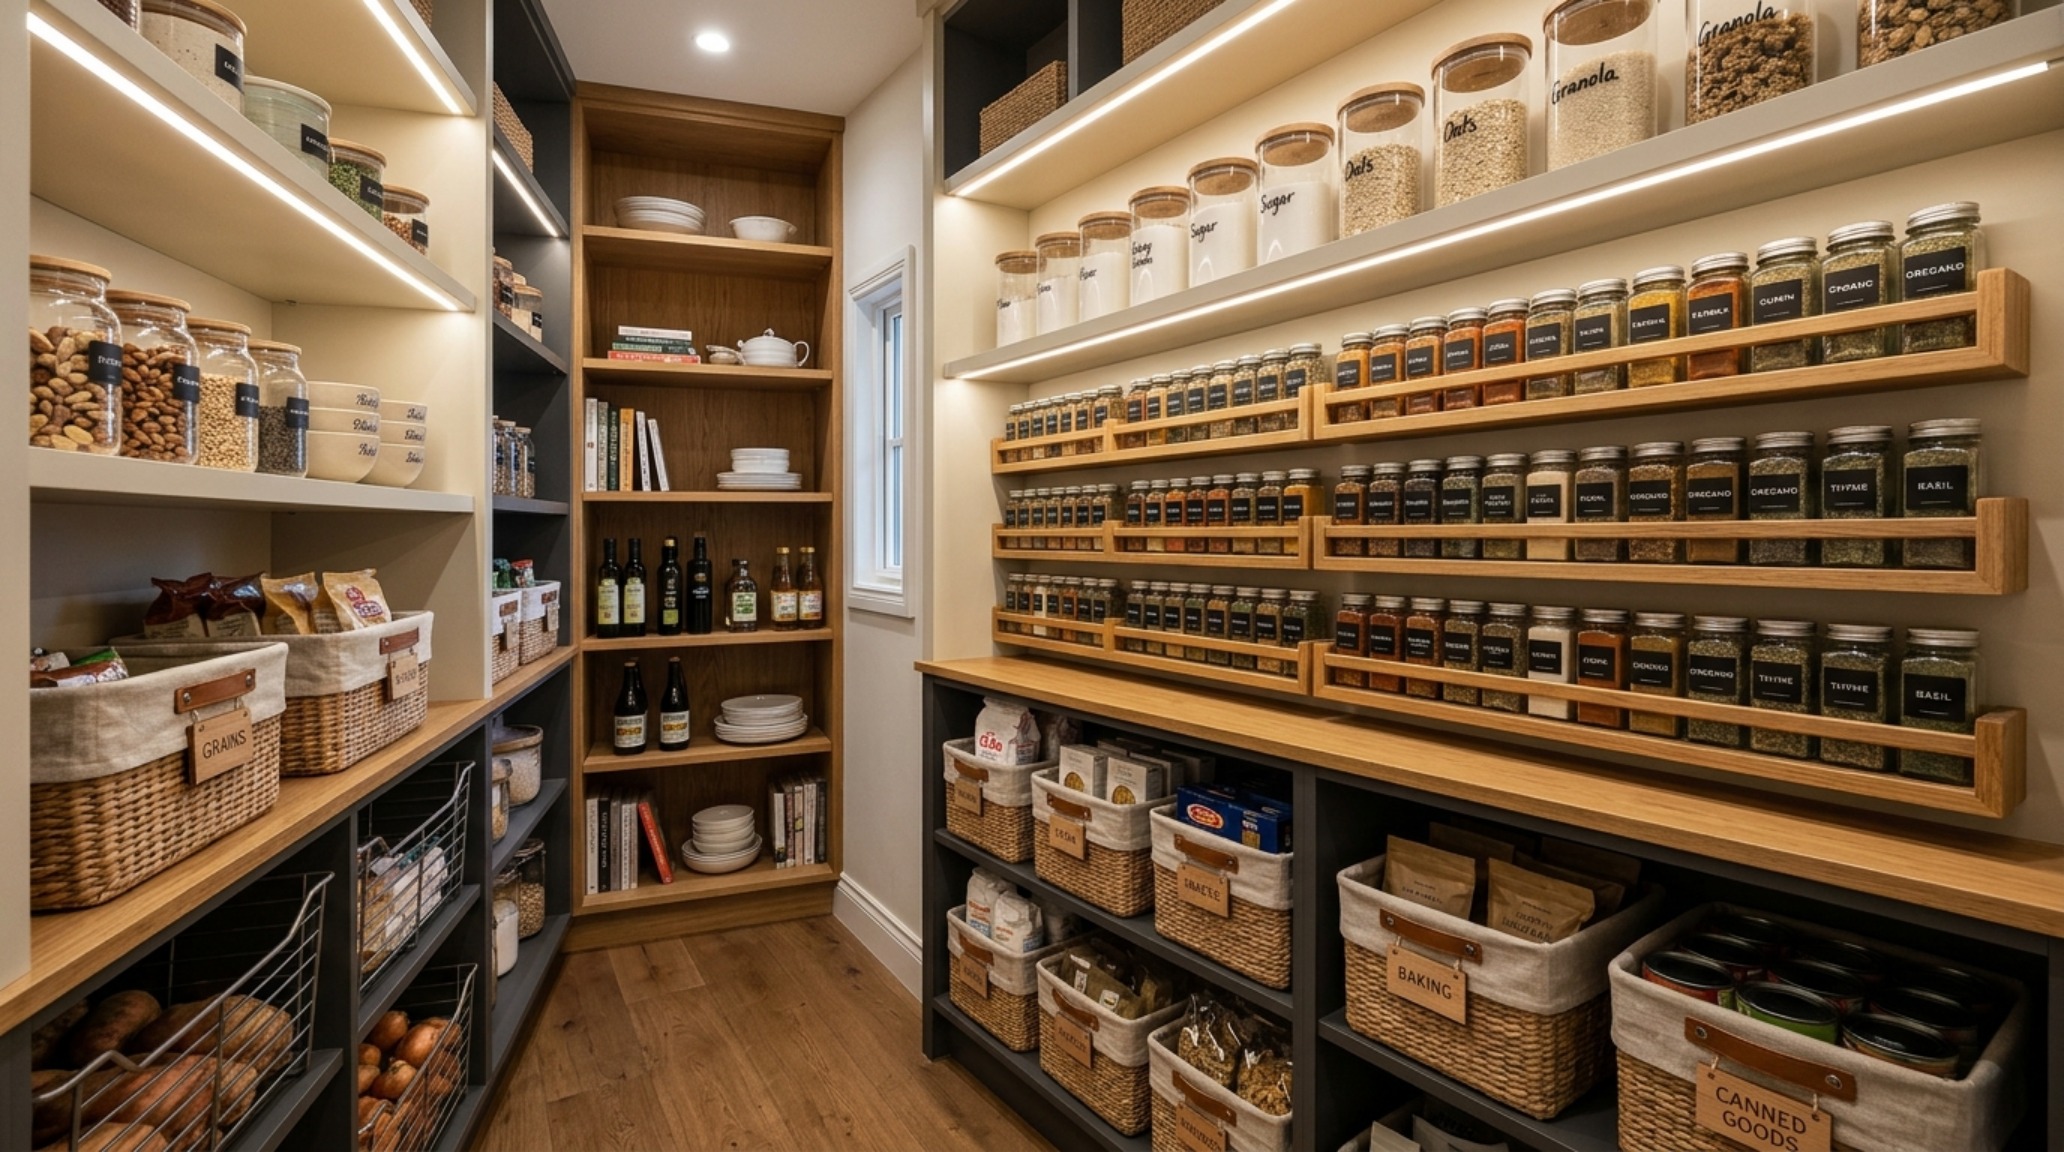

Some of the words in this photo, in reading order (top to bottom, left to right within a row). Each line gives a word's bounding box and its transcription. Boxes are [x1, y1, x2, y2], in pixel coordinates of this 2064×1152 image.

[1698, 0, 1779, 48] Granola
[1551, 62, 1619, 105] Granola
[1260, 192, 1295, 216] Sugar
[1191, 221, 1218, 243] Sugar
[1398, 965, 1452, 1000] BAKING
[1715, 1086, 1806, 1135] CANNED
[1722, 1110, 1799, 1152] GOODS
